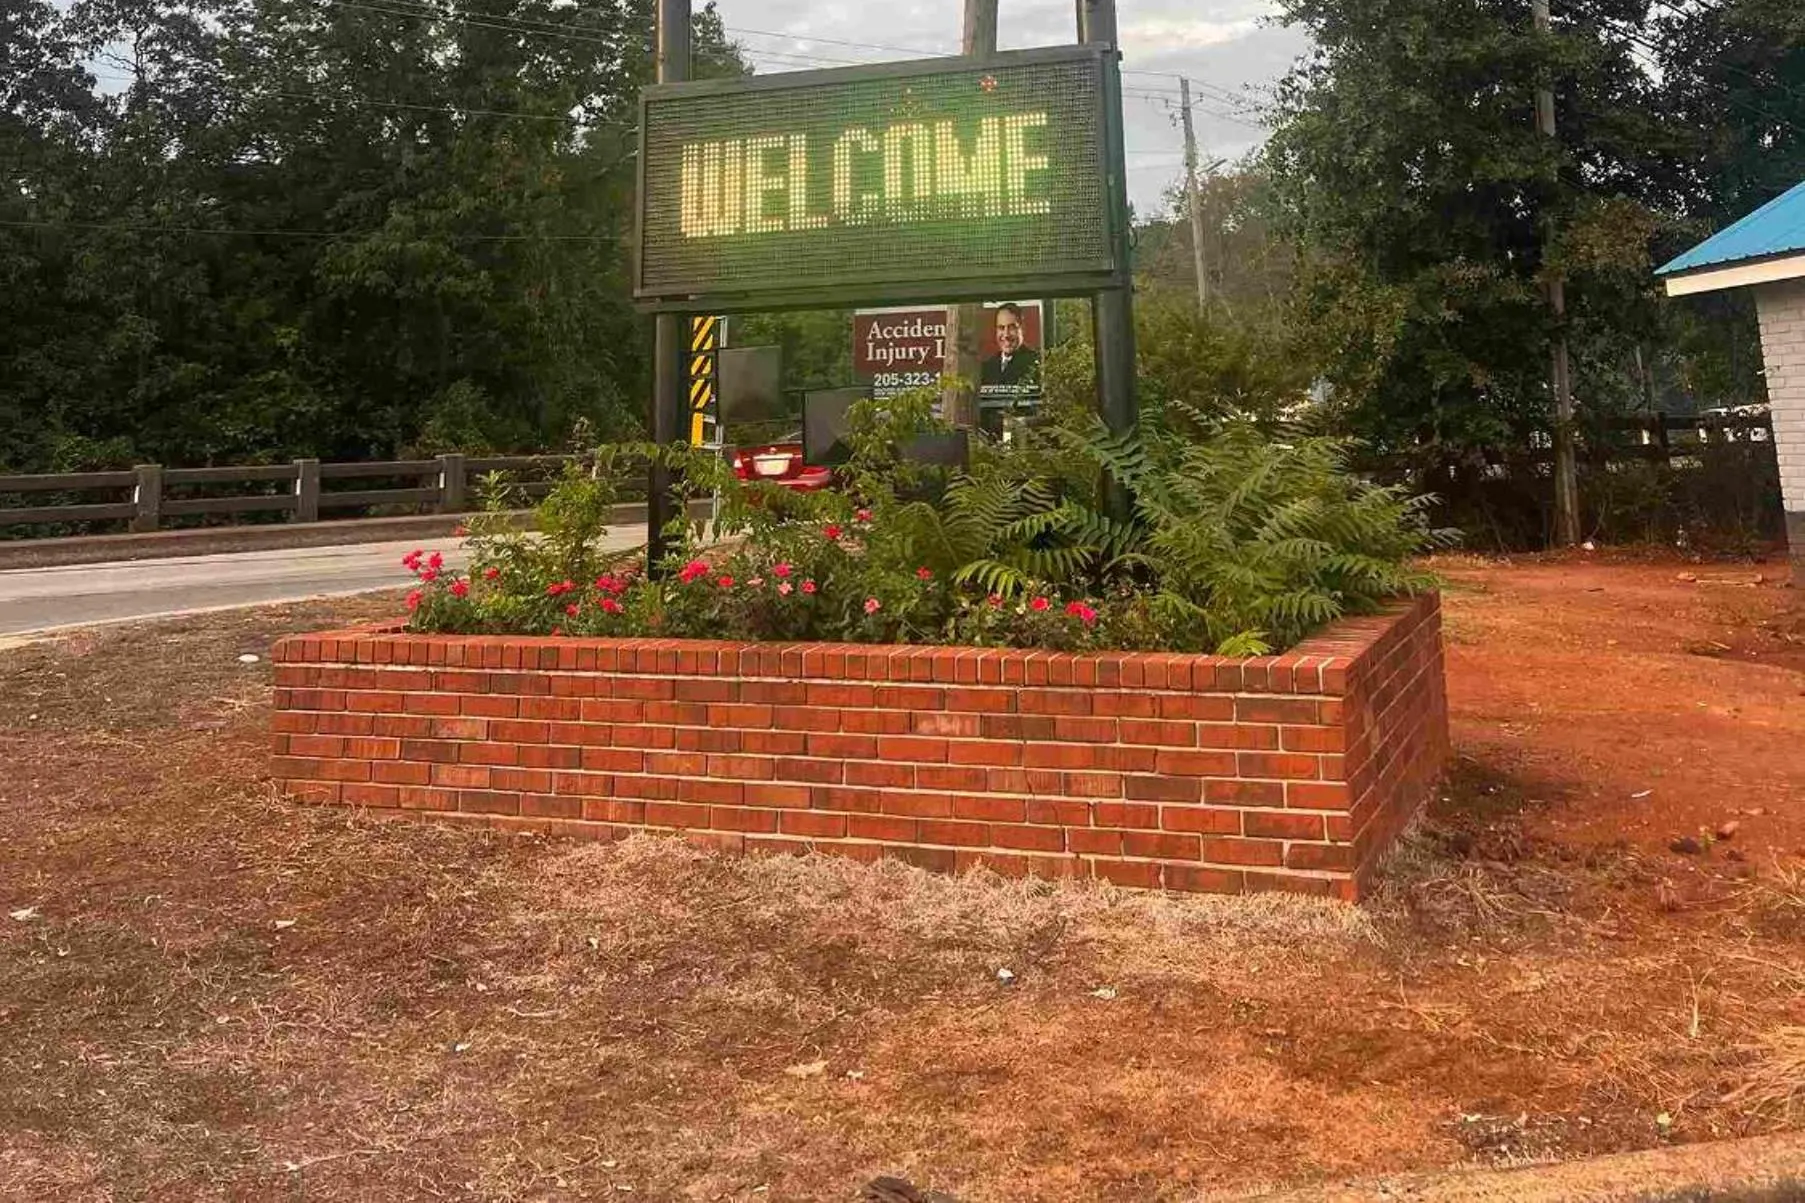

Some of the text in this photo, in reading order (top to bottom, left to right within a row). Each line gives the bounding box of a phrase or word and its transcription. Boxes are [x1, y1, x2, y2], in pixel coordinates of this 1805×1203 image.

[680, 112, 1051, 238] WELCOME
[868, 318, 946, 340] Acciden
[866, 341, 931, 367] Injury
